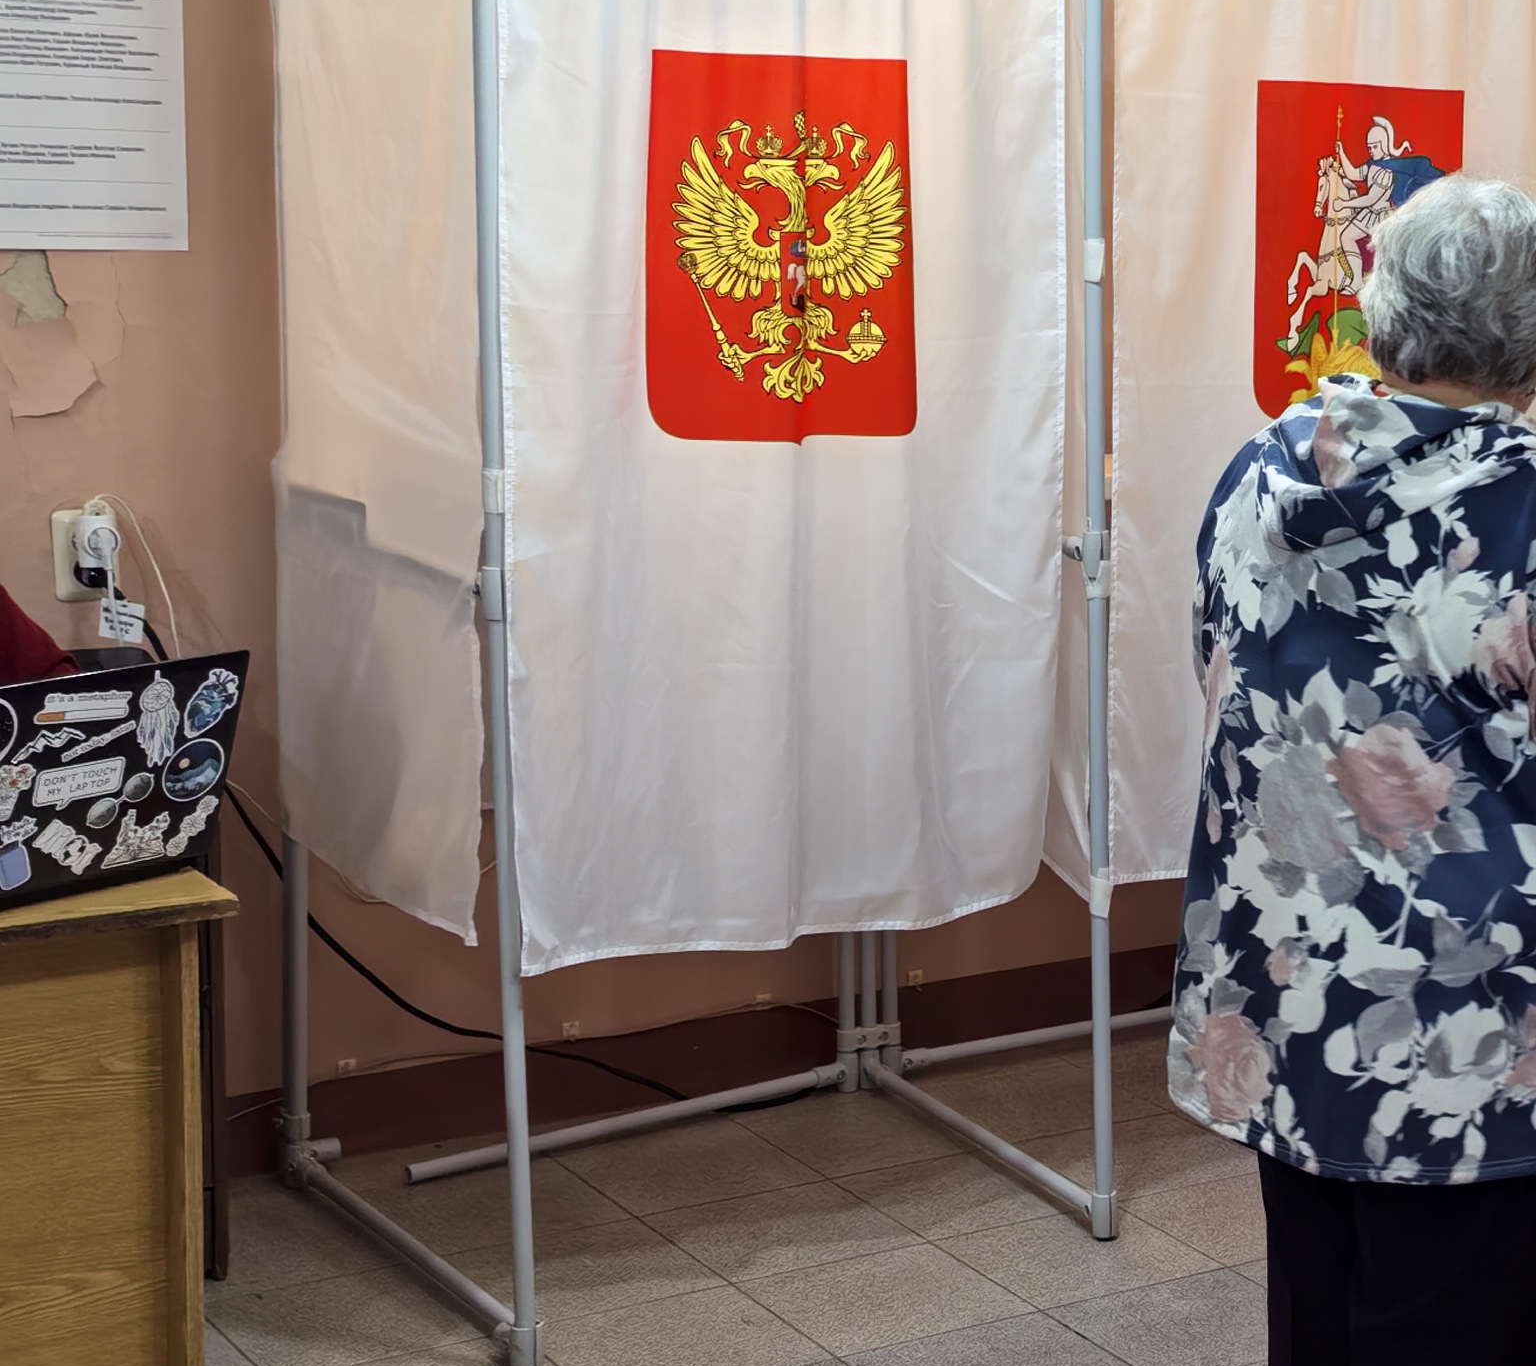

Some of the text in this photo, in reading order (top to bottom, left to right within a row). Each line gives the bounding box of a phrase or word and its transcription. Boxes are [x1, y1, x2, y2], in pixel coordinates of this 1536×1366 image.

[83, 766, 117, 779] TOUCH
[47, 778, 110, 797] MY LAPTOP
